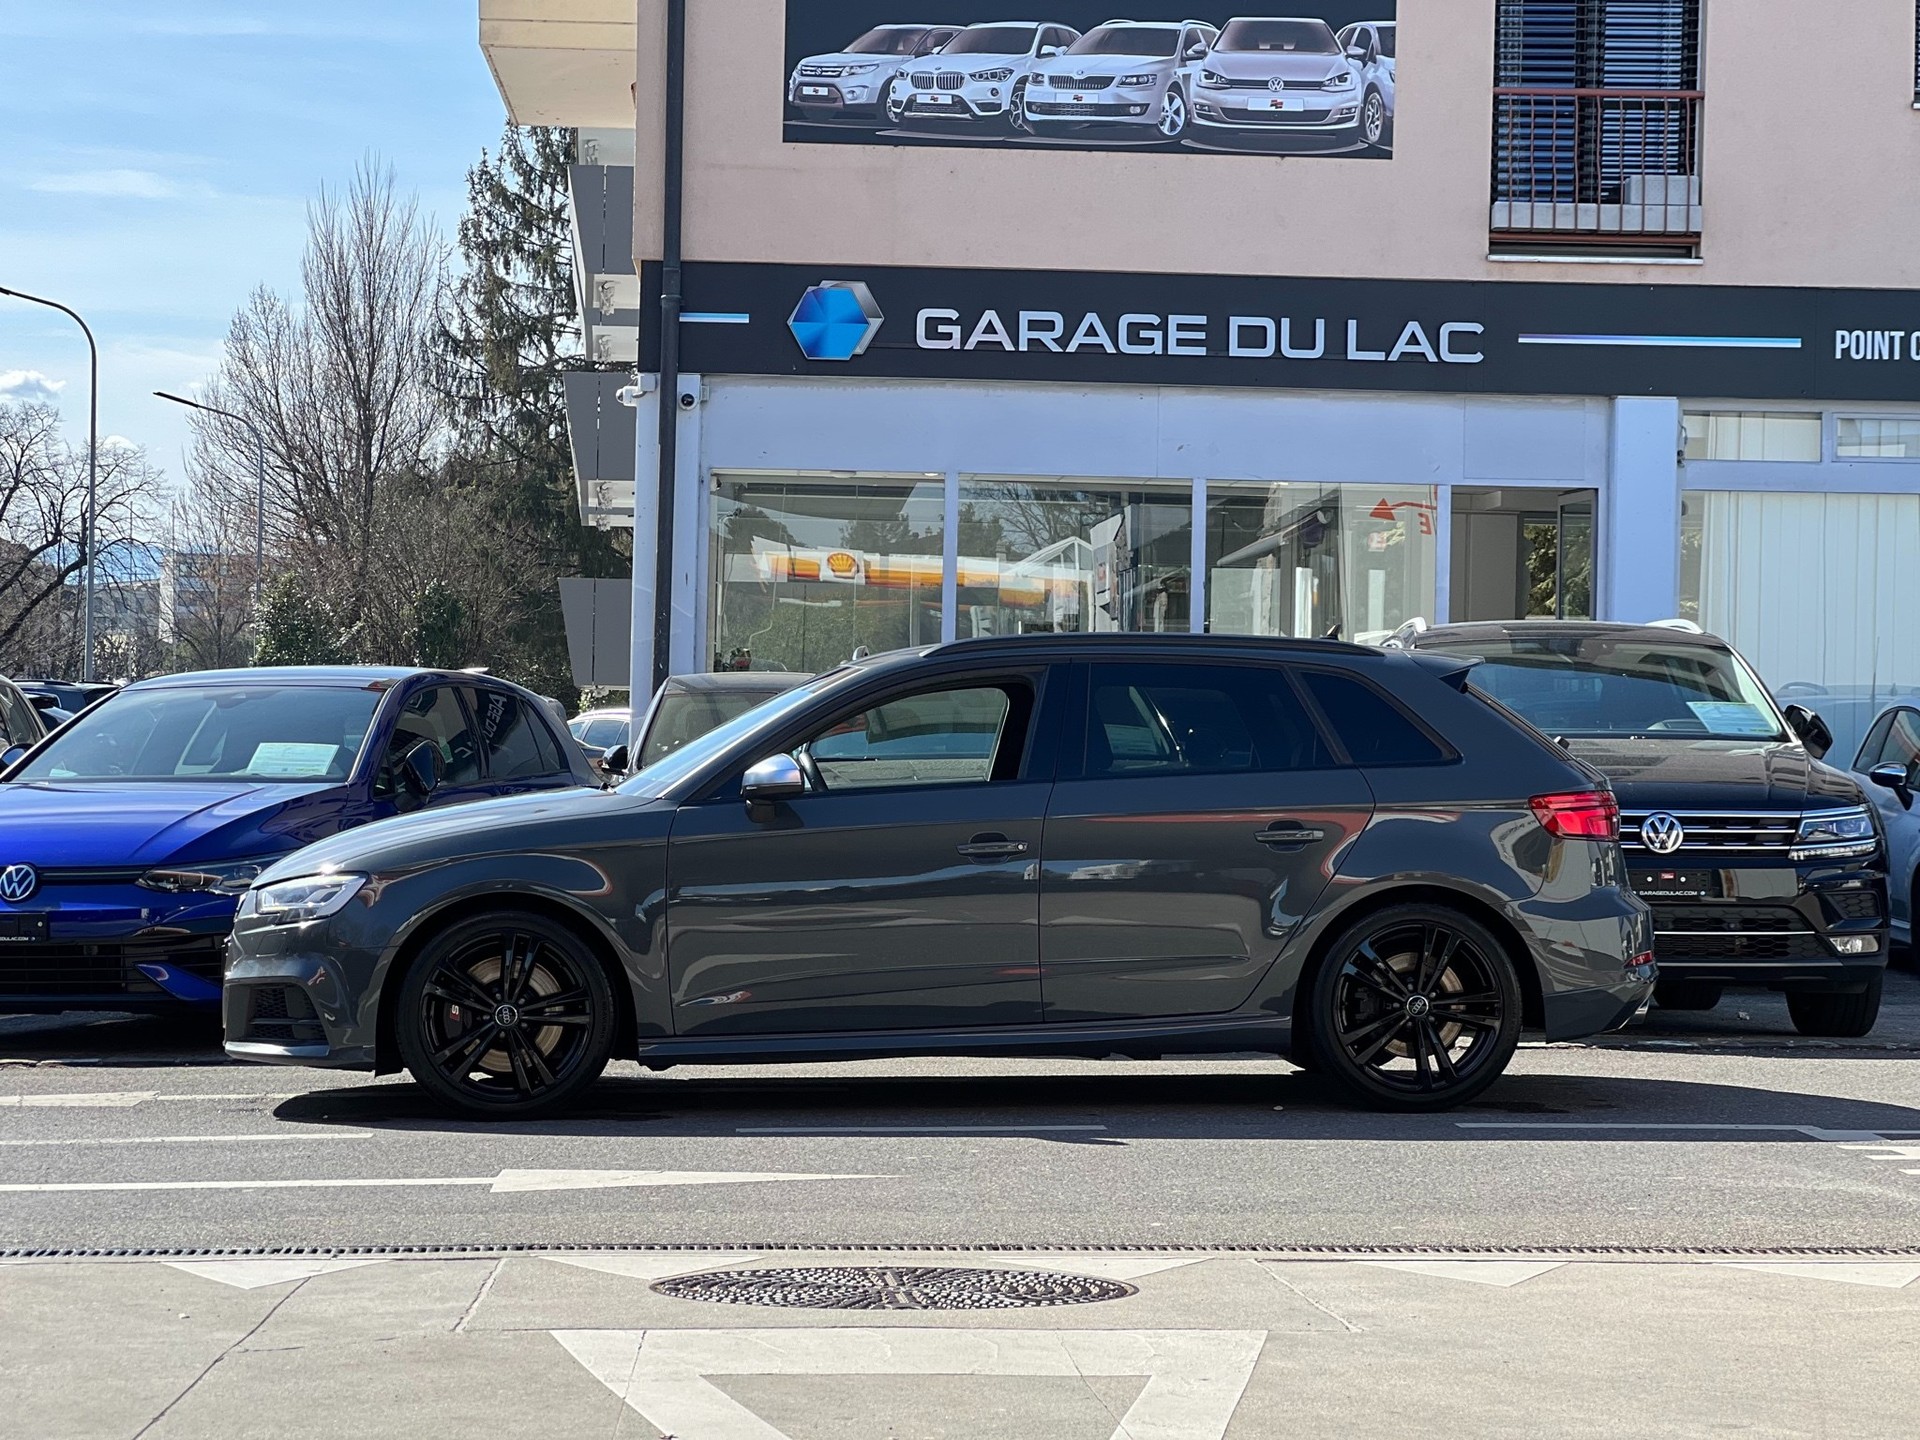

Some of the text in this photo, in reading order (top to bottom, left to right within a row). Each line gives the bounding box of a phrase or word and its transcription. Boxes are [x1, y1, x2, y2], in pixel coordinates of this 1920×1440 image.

[915, 307, 1486, 364] GARAGE DU LAC
[1834, 329, 1906, 361] POINT
